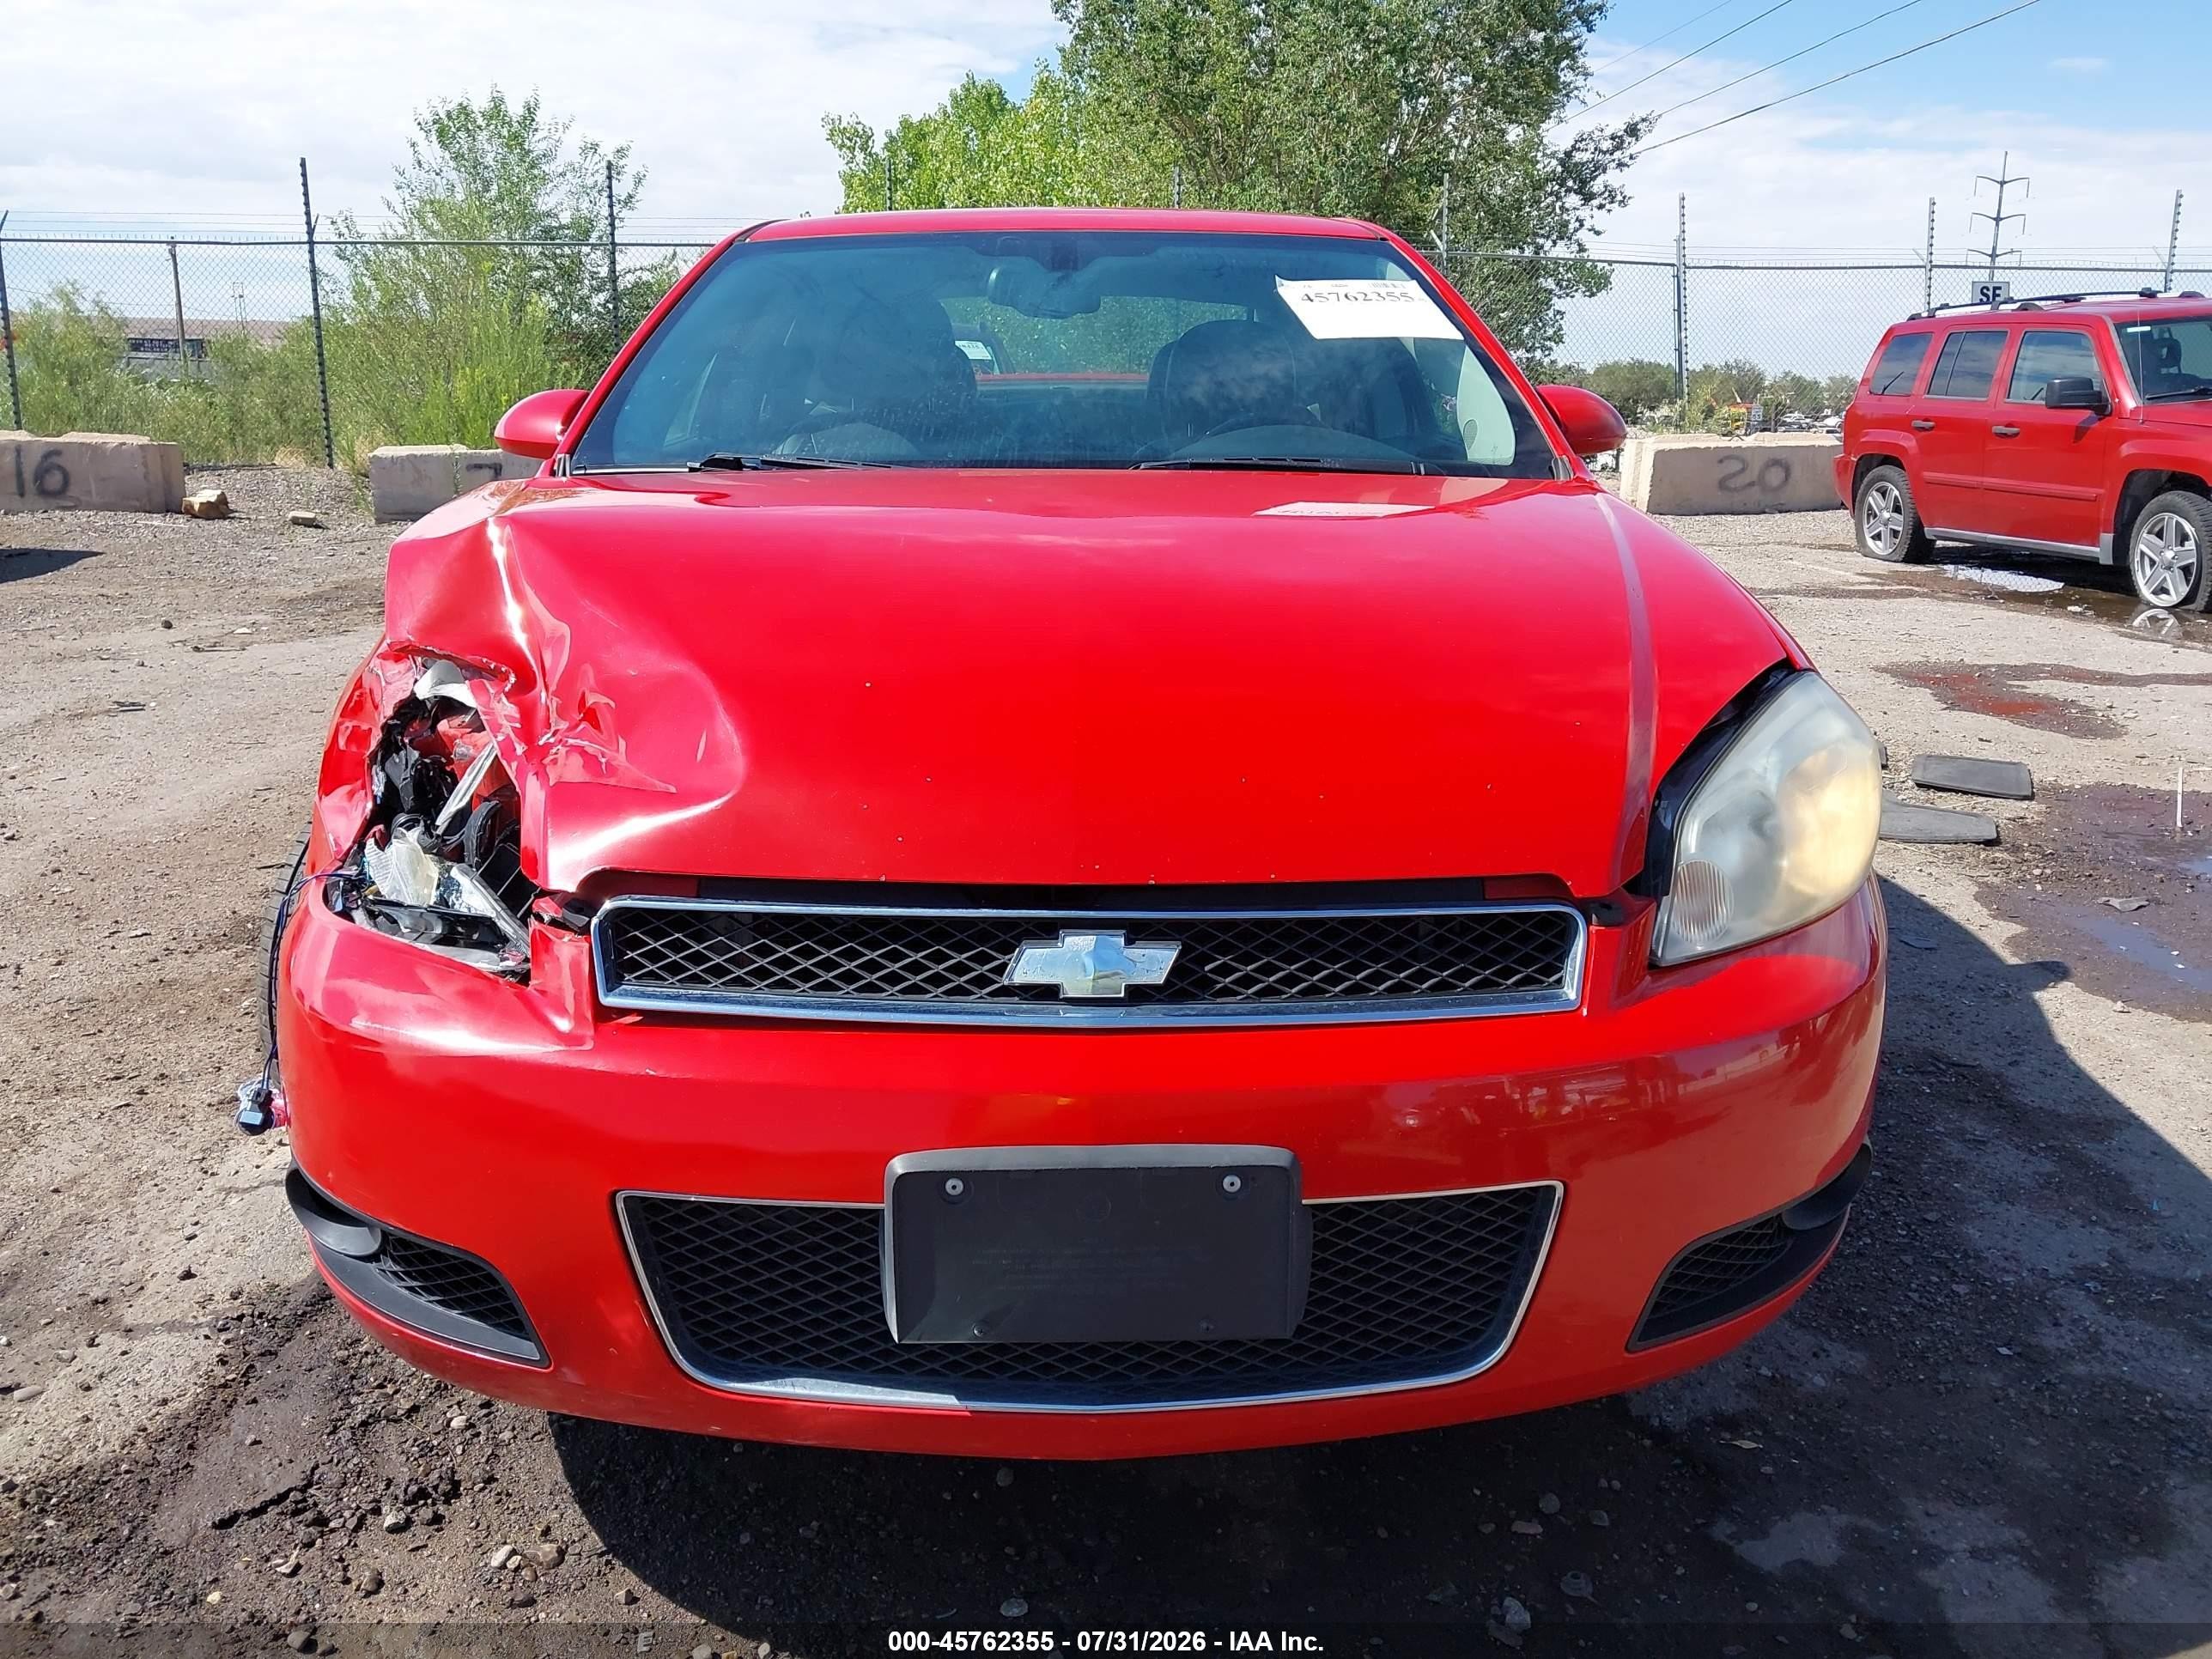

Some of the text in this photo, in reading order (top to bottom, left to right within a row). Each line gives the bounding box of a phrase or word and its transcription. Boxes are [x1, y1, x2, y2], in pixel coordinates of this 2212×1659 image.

[1301, 291, 1415, 303] 45762355
[15, 443, 70, 498] 16
[1718, 454, 1791, 493] 20
